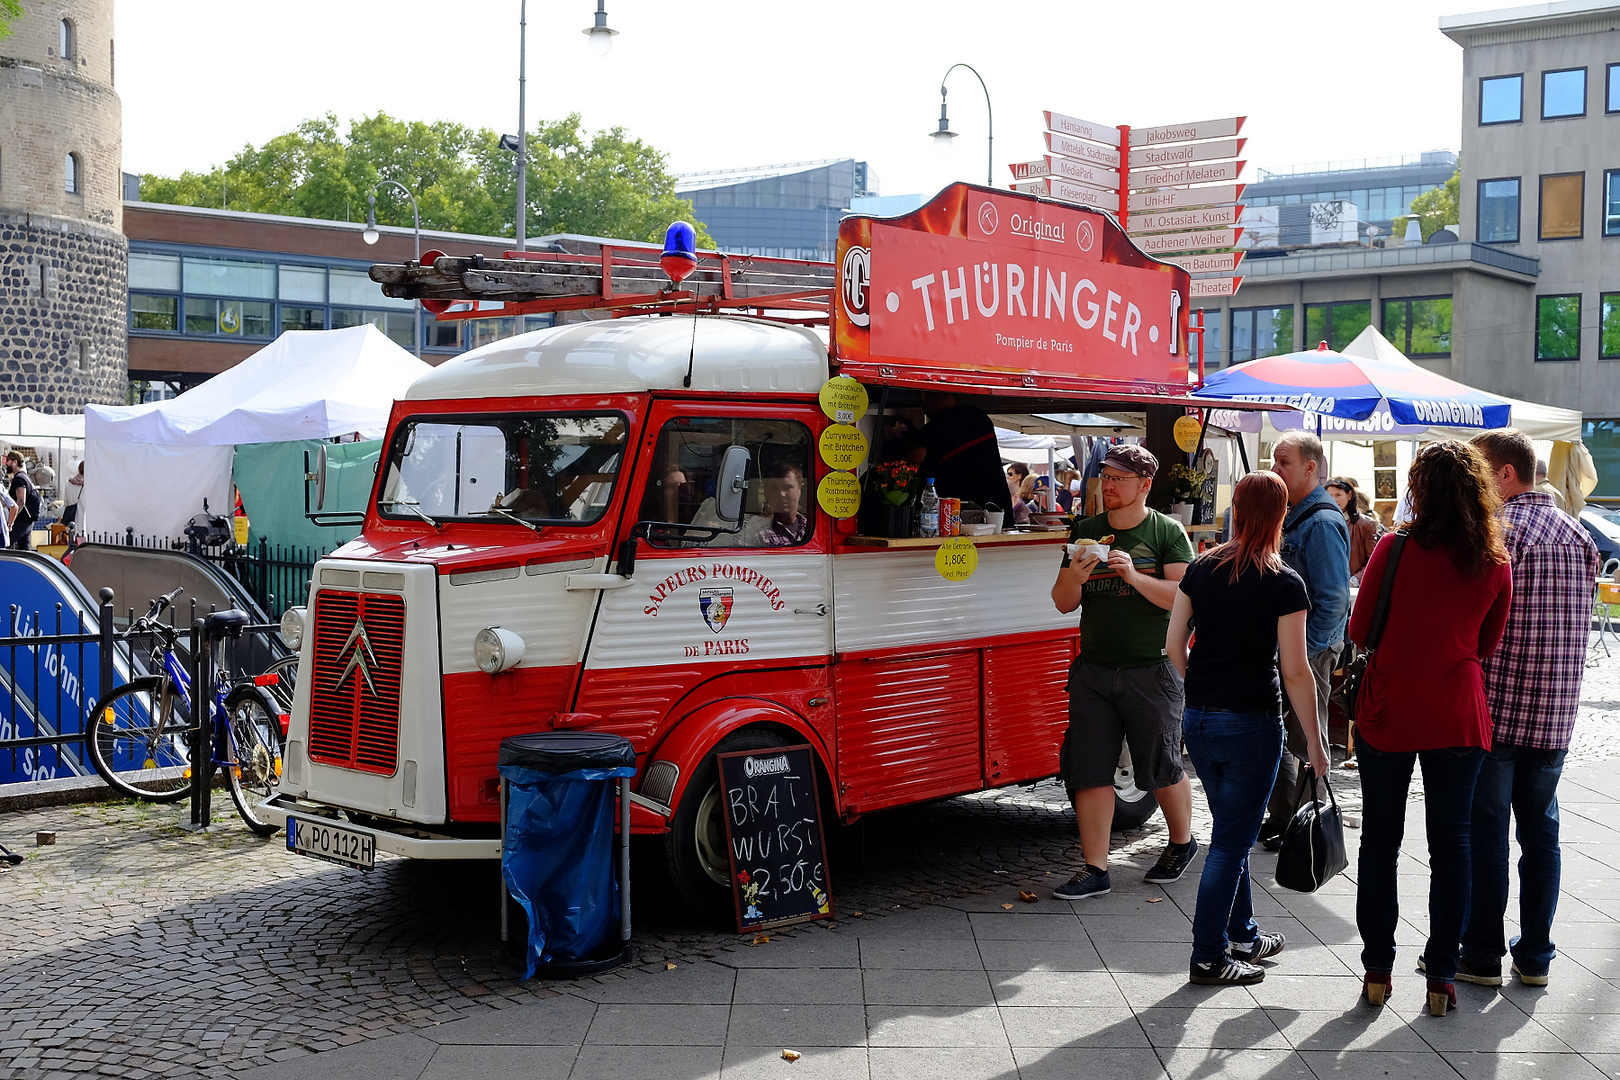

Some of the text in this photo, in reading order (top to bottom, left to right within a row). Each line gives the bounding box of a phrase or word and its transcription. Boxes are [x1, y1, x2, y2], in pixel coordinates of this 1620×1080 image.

[1061, 120, 1092, 138] Hansaring
[1146, 128, 1196, 144] Jakobsweg
[1061, 140, 1118, 164] Mittelalt. Stadtmauer
[1146, 147, 1194, 162] Stadtwald
[1060, 162, 1094, 180] MediaPark
[1144, 168, 1226, 184] Friedhof Melaten
[1060, 186, 1098, 204] Friesenplatz
[1144, 194, 1176, 206] Uni-HF
[1010, 214, 1065, 240] Original
[1144, 211, 1230, 228] M. Ostasiat. Kunst
[1144, 234, 1226, 249] Aachener Weiher
[1194, 258, 1233, 269] Bauturm
[912, 261, 1142, 357] THÜRINGER
[996, 333, 1073, 353] Pompier de Paris
[1412, 399, 1484, 426] ORANGINA
[825, 431, 860, 441] Currywurst
[835, 443, 864, 452] Brötchen
[827, 477, 856, 487] Thüringer
[945, 554, 966, 566] 1,80€
[644, 563, 785, 617] SAPEURS POMPIERS
[684, 638, 750, 657] DE PARIS
[744, 755, 790, 778] ORANGINA
[729, 776, 800, 826] BRAT
[296, 823, 304, 846] K
[312, 827, 329, 852] PO
[333, 832, 371, 862] 112H
[732, 818, 814, 862] WURST
